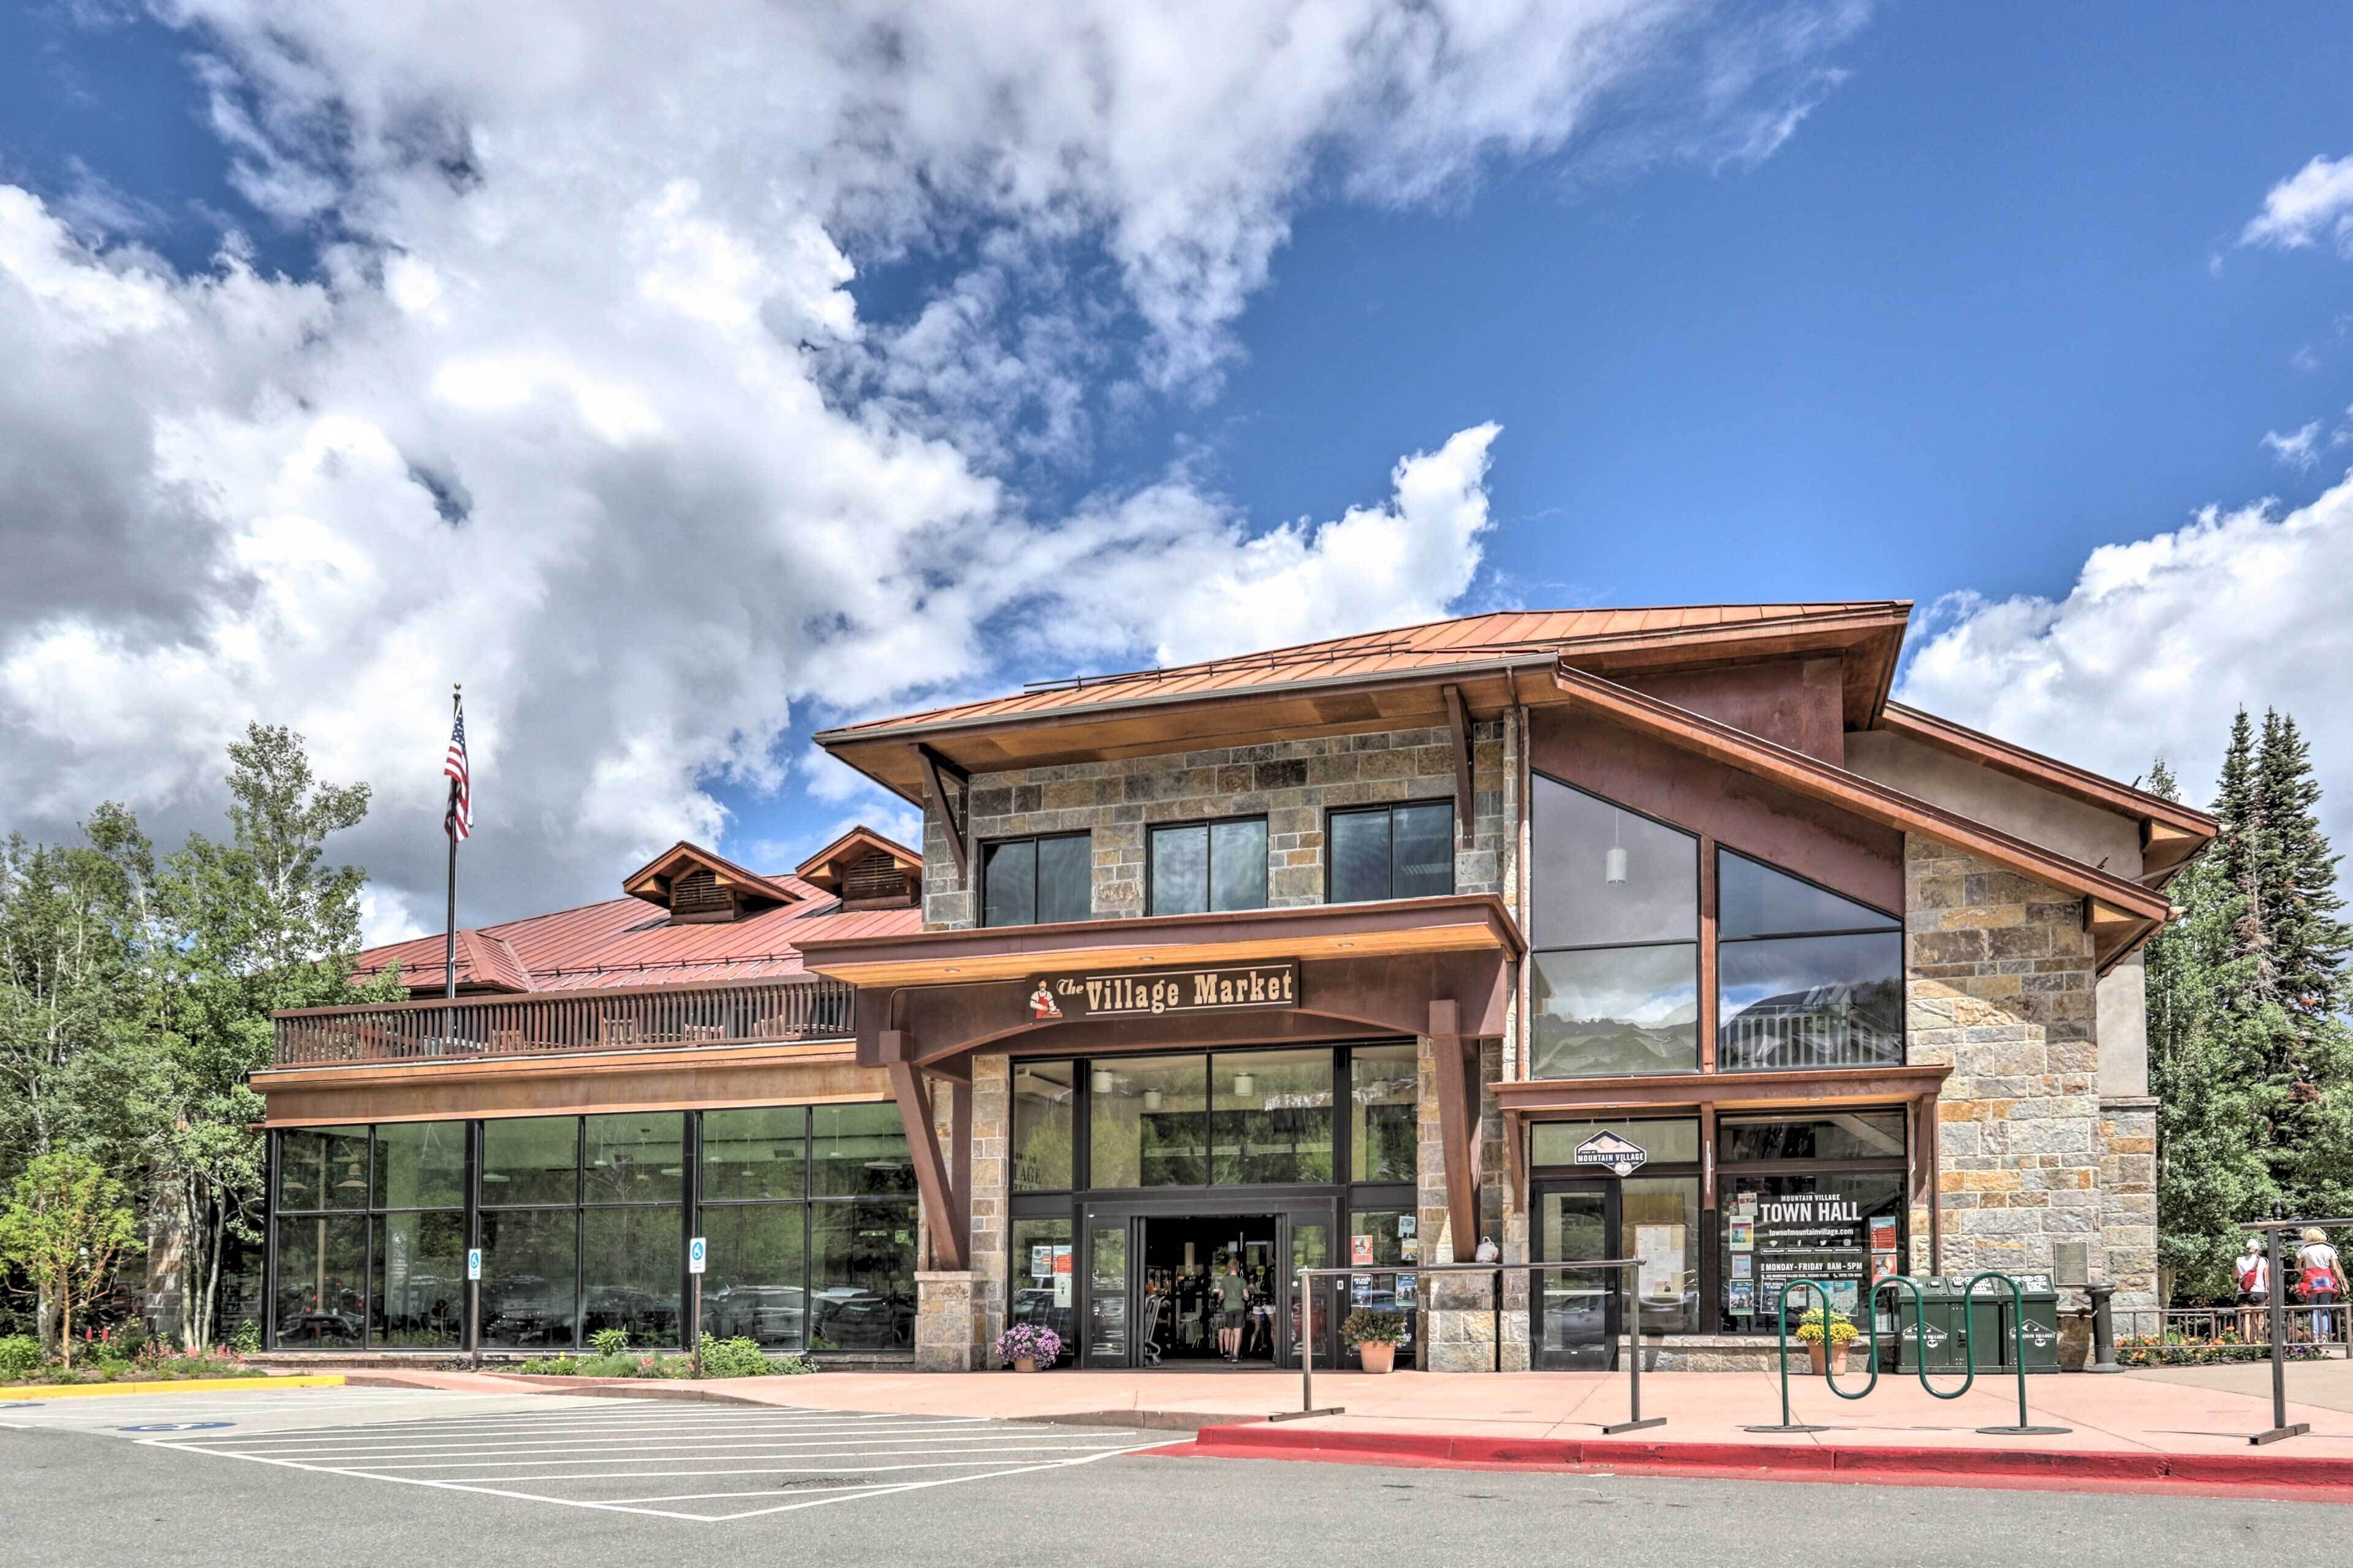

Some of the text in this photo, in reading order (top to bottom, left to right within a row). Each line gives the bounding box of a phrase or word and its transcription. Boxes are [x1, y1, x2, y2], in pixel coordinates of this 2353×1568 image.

[1056, 969, 1292, 1014] The Village Market
[1578, 1153, 1643, 1162] MOUNTAIN VILLAGE
[1014, 1164, 1041, 1184] LAGE
[1760, 1202, 1862, 1223] TOWN HALL
[1769, 1228, 1854, 1237] townofmountainvillage.com
[1765, 1263, 1794, 1271] MONDAY
